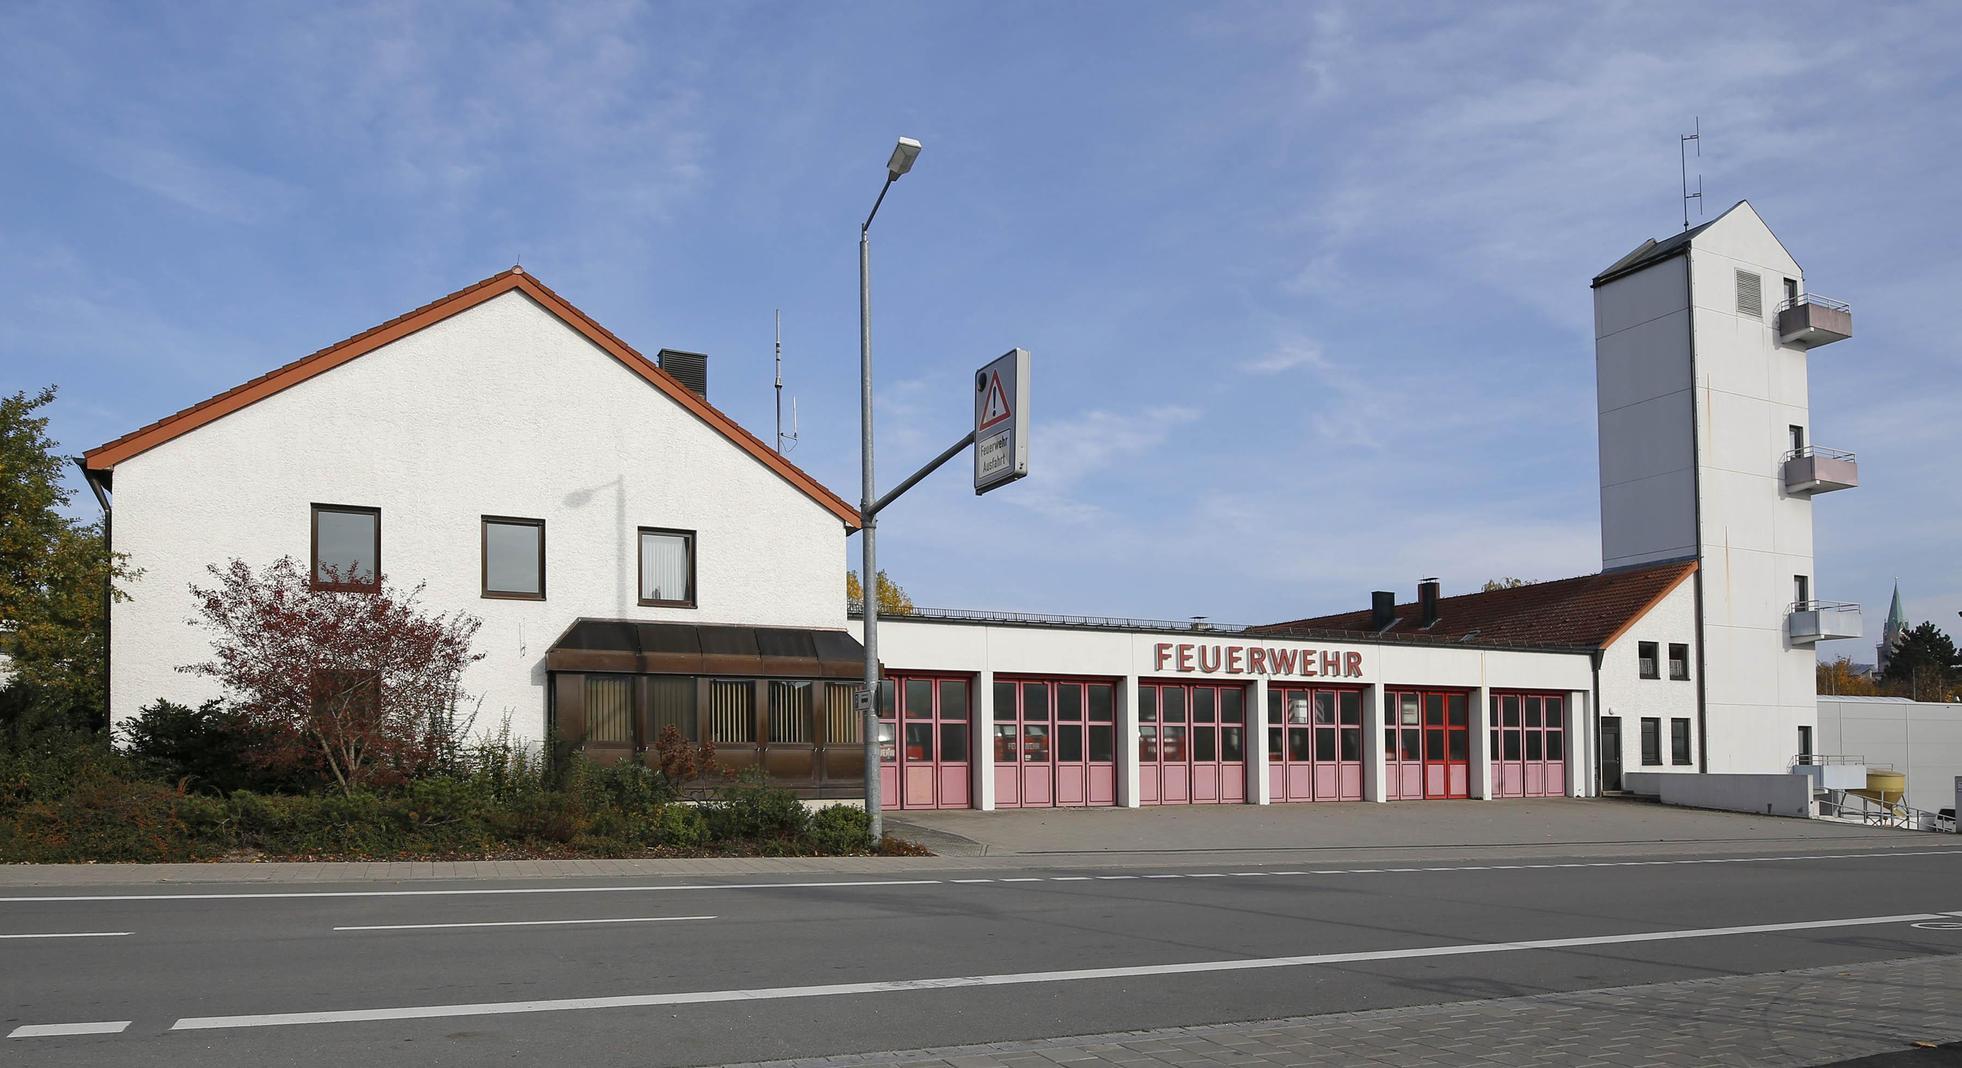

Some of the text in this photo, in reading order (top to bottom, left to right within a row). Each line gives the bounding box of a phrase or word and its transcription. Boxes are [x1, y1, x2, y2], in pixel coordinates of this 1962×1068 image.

[981, 435, 1008, 456] Feuerwehr
[983, 453, 1006, 472] Ausfahrt
[1154, 642, 1363, 677] FEUERWEHR
